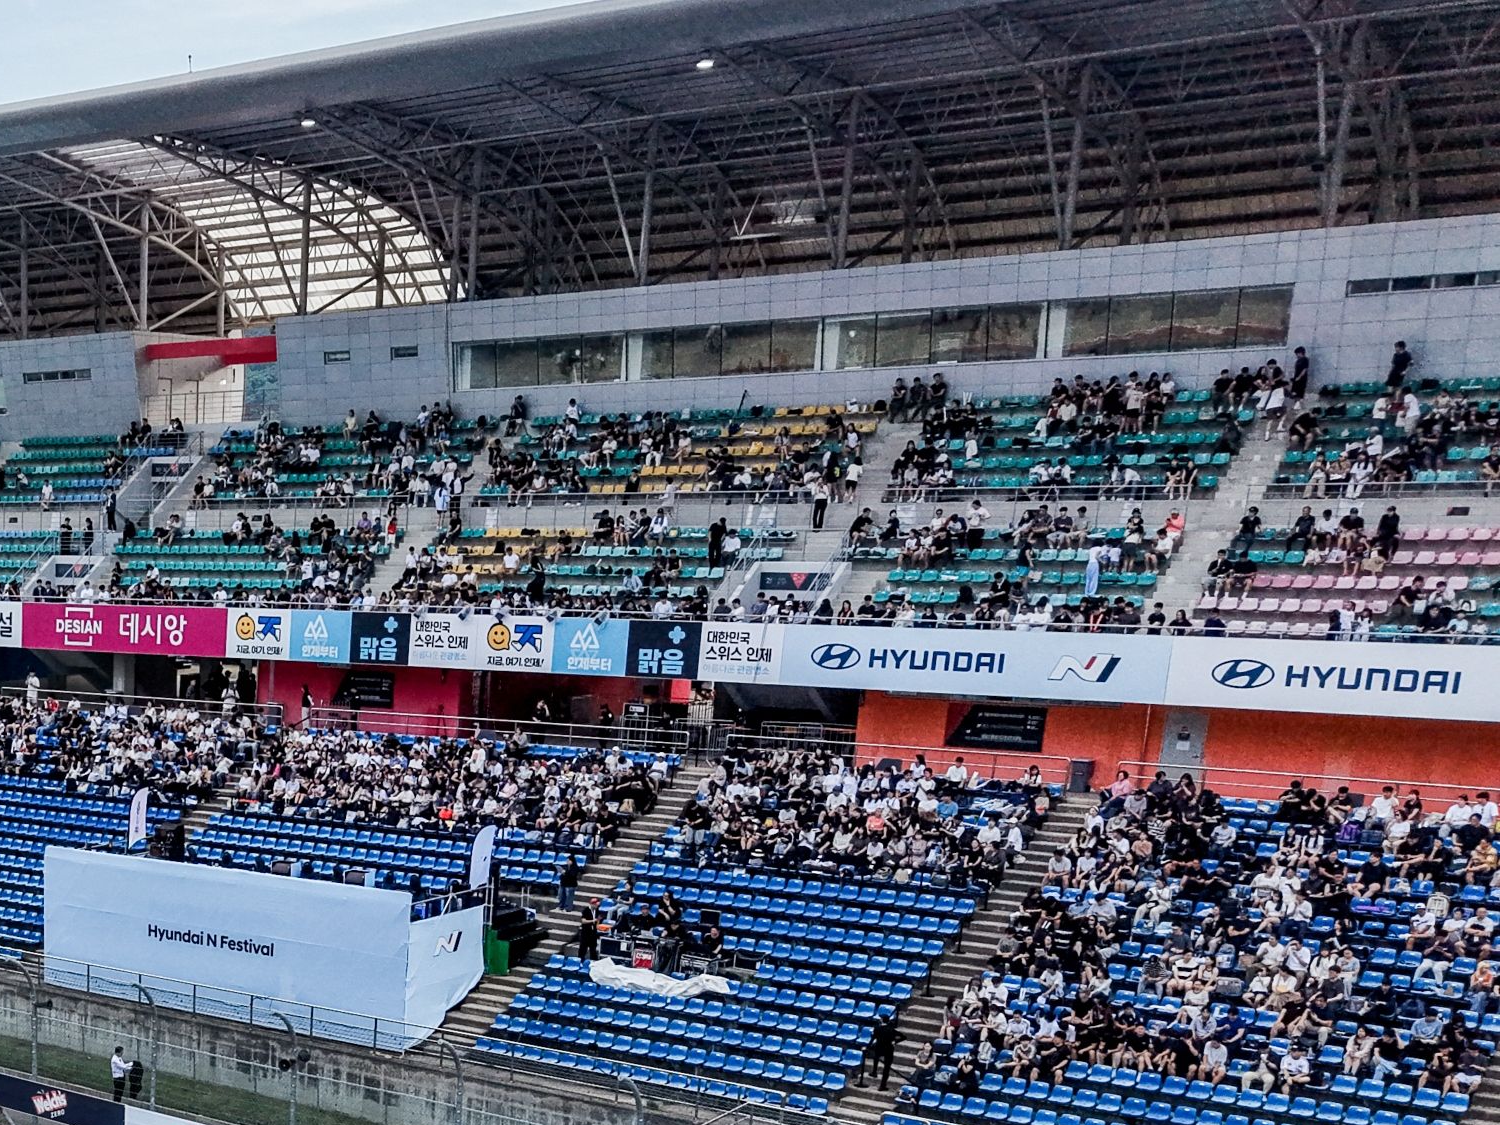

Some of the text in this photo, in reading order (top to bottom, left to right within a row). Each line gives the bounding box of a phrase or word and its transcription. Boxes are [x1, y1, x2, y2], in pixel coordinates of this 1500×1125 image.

[55, 618, 102, 635] DESIAN
[118, 613, 187, 646] 데시앙
[415, 620, 450, 633] 대한민국
[707, 630, 750, 645] 대한민국
[359, 636, 397, 661] 맑음
[414, 634, 468, 650] 스위스 인제
[705, 646, 772, 663] 스위스 인제
[638, 648, 684, 676] 맑음
[868, 648, 1005, 674] HYUNDAI
[1284, 664, 1462, 695] HYUNDAI
[147, 923, 275, 957] Hyundai N Festival
